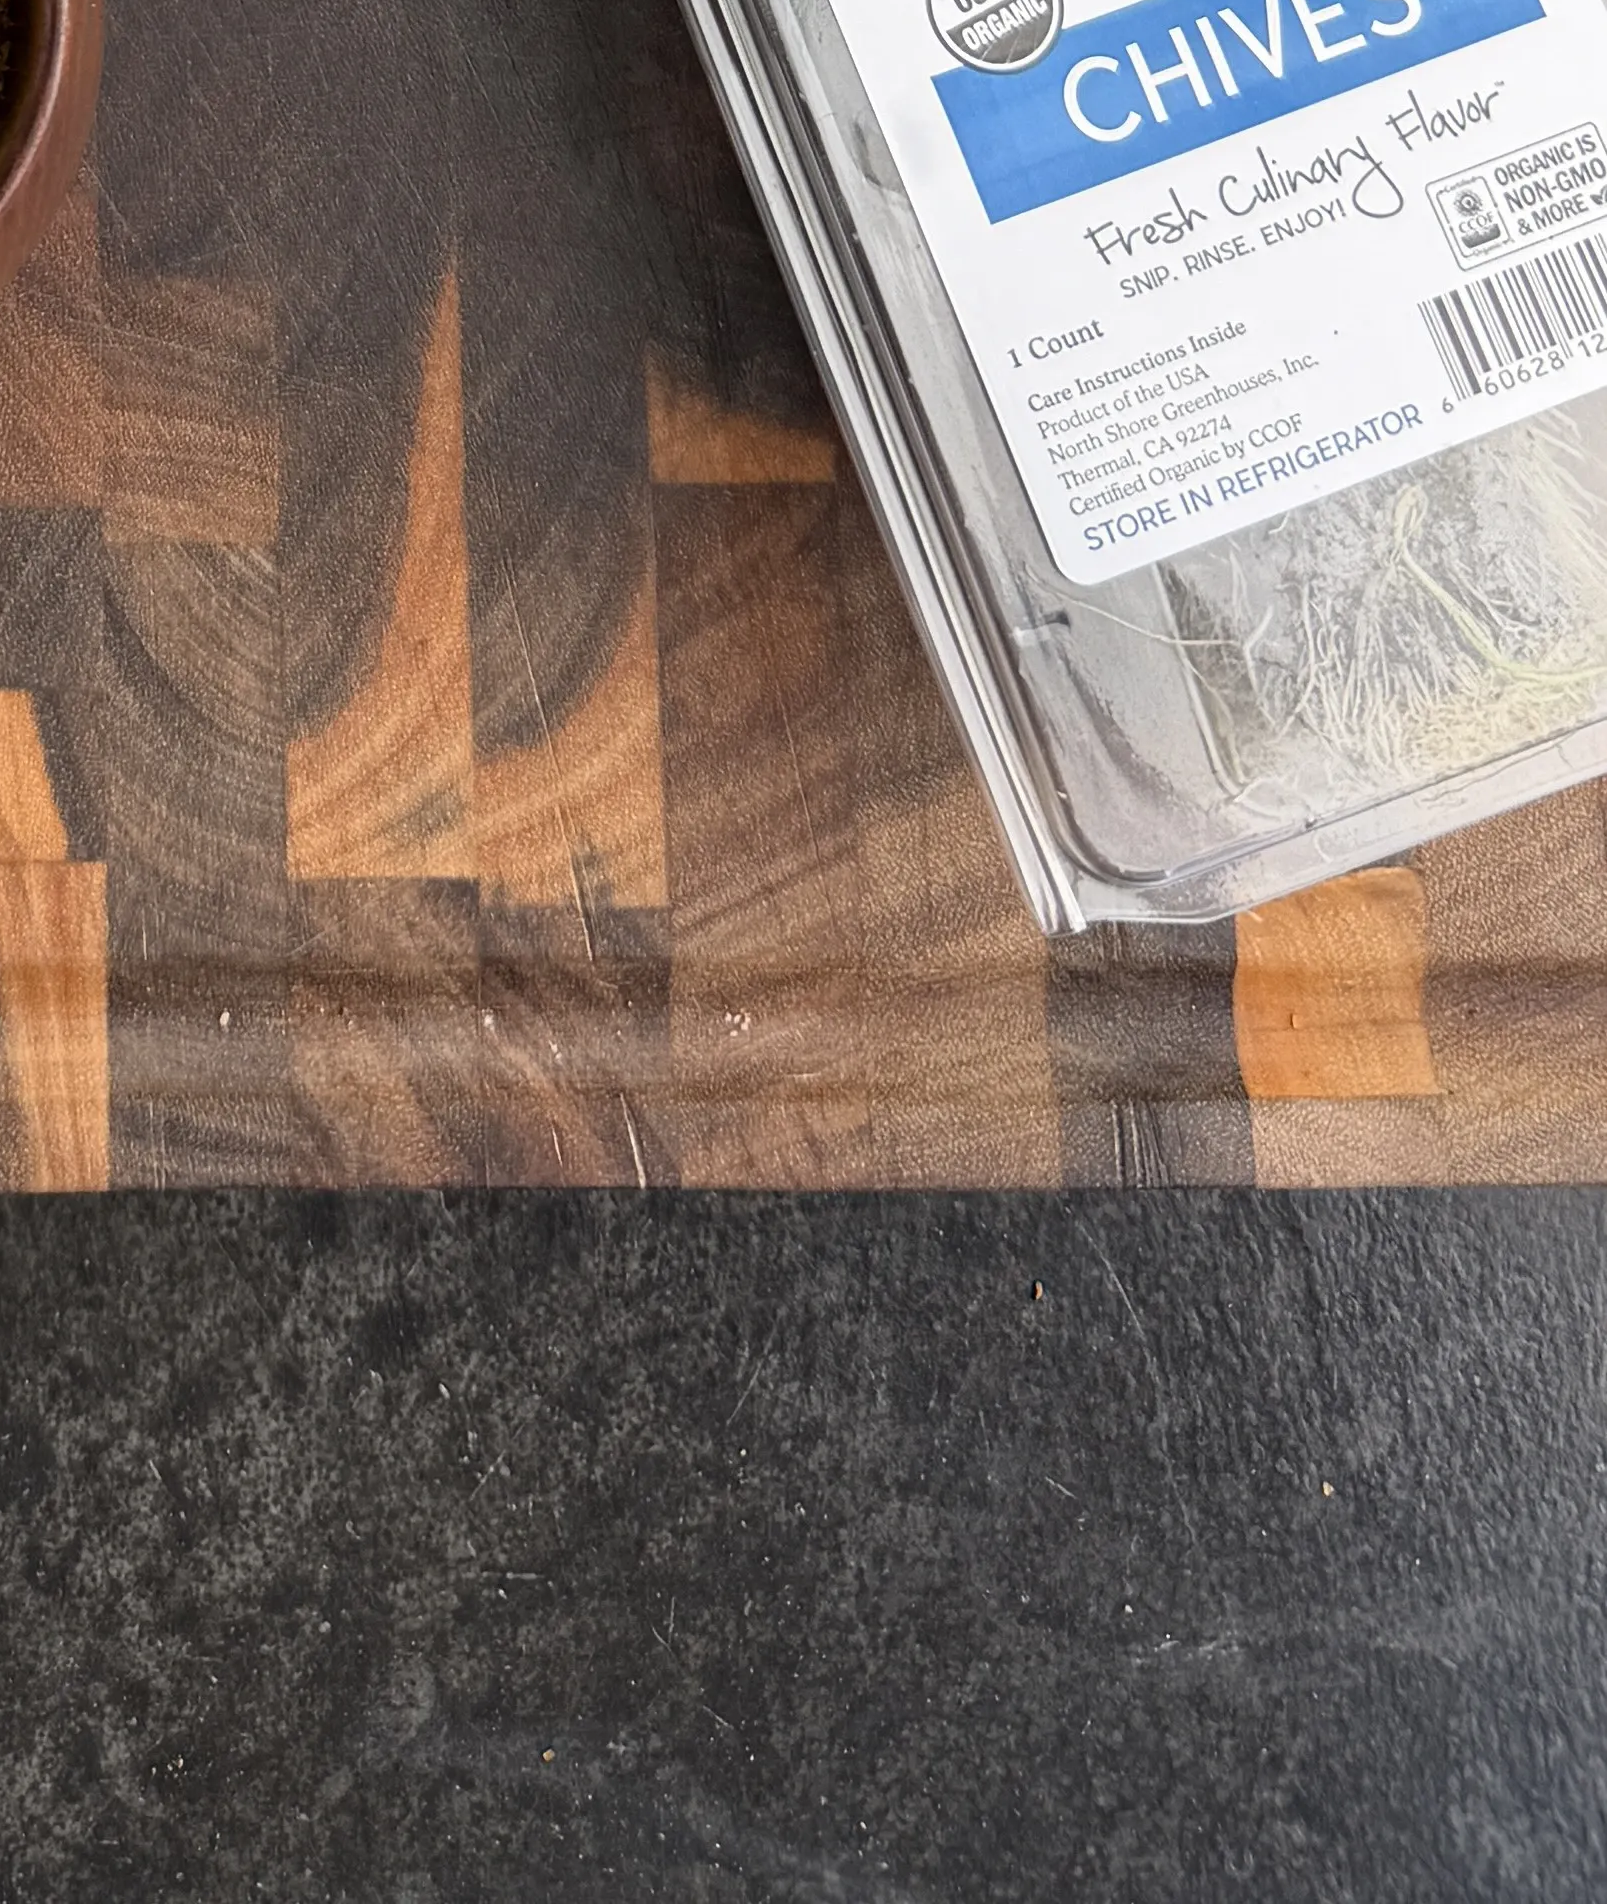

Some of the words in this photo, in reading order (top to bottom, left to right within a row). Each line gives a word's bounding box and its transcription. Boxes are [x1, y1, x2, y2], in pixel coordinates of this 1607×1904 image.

[1084, 187, 1209, 266] Fresh
[1218, 135, 1405, 219] Culinary
[1384, 89, 1500, 152] Flavor
[1494, 141, 1576, 186] ORGANIC
[1575, 134, 1597, 156] IS
[1503, 157, 1607, 213] NON-GMO
[1119, 264, 1179, 299] SNIP.
[1183, 235, 1257, 276] RINSE.
[1262, 197, 1347, 246] ENJOY!
[1458, 211, 1495, 234] CCOF
[1517, 218, 1534, 236] &
[1531, 193, 1589, 230] MORE
[1006, 347, 1023, 369] 1
[1028, 319, 1105, 361] Count
[1026, 386, 1074, 414] Care
[1075, 341, 1188, 397] Instructions
[1190, 320, 1247, 354] Inside
[1442, 397, 1455, 414] 6
[1484, 350, 1565, 396] 60628
[1037, 403, 1111, 441] Product
[1113, 391, 1134, 413] of
[1135, 378, 1165, 405] the
[1165, 363, 1211, 392] USA
[1047, 432, 1105, 467] North
[1106, 413, 1160, 445] Shore
[1162, 369, 1283, 424] Greenhouses,
[1285, 352, 1320, 377] Inc.
[1057, 452, 1143, 491] Thermal,
[1143, 435, 1175, 459] CA
[1175, 413, 1233, 449] 92274
[1068, 473, 1148, 516] Certified
[1148, 448, 1222, 487] Organic
[1224, 437, 1246, 461] by
[1247, 412, 1304, 448] CCOF
[1082, 496, 1178, 552] STORE
[1183, 484, 1215, 516] IN
[1215, 402, 1424, 504] REFRIGERATOR
